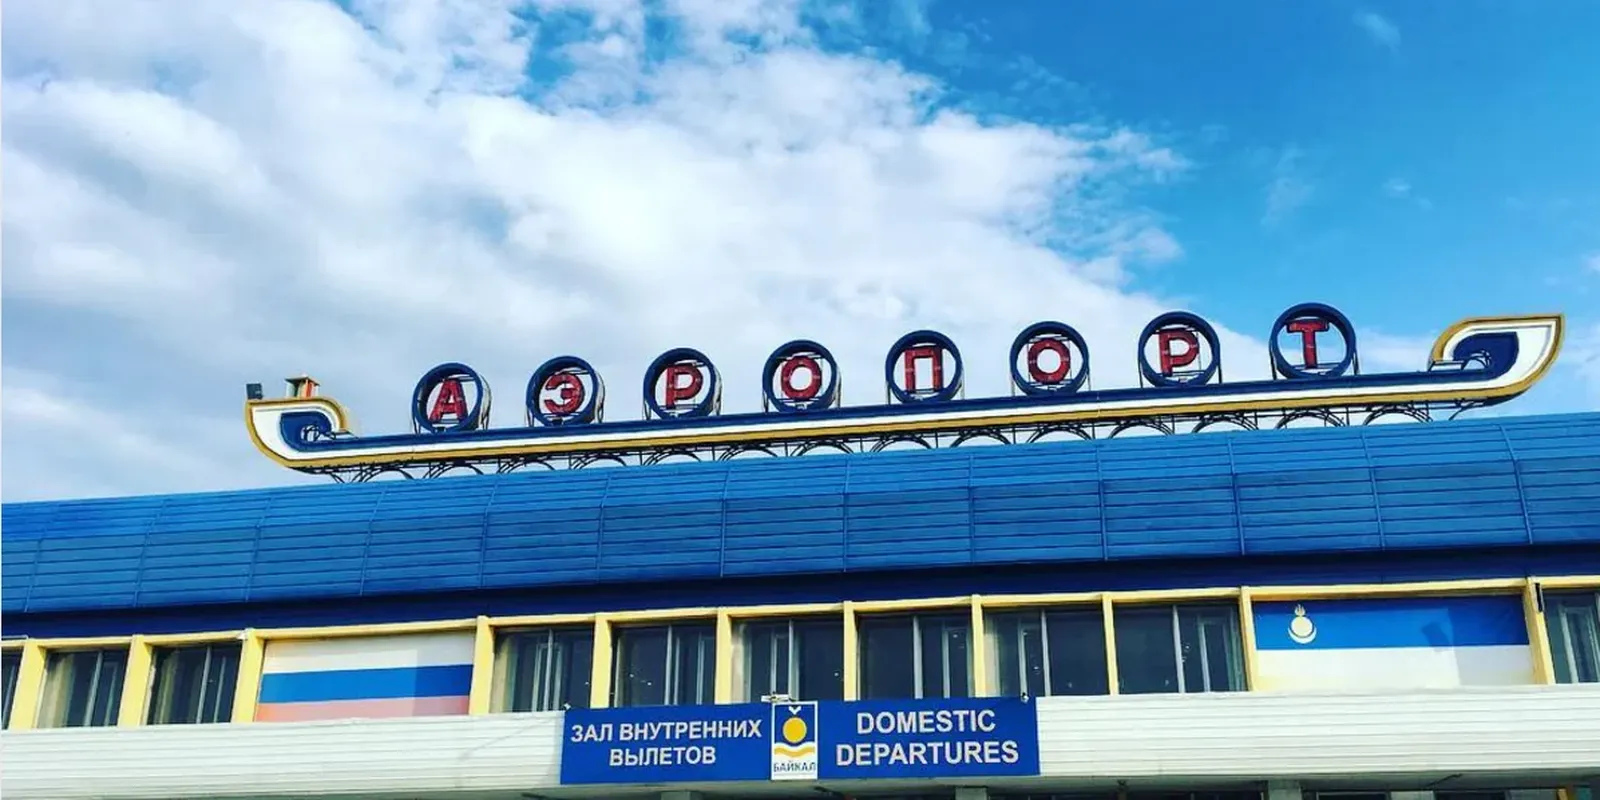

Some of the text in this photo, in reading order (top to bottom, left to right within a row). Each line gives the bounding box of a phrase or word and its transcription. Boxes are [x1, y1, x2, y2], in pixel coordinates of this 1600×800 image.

[429, 319, 1330, 423] АЭРОПОРТ
[571, 719, 762, 742] ЗАЛ ВНУТРЕННИХ
[857, 708, 996, 734] DOMESTIC
[609, 746, 717, 767] ВЫЛЕТОВ
[836, 740, 1019, 766] DEPARTURES
[773, 760, 817, 772] БАЙКАЛ
